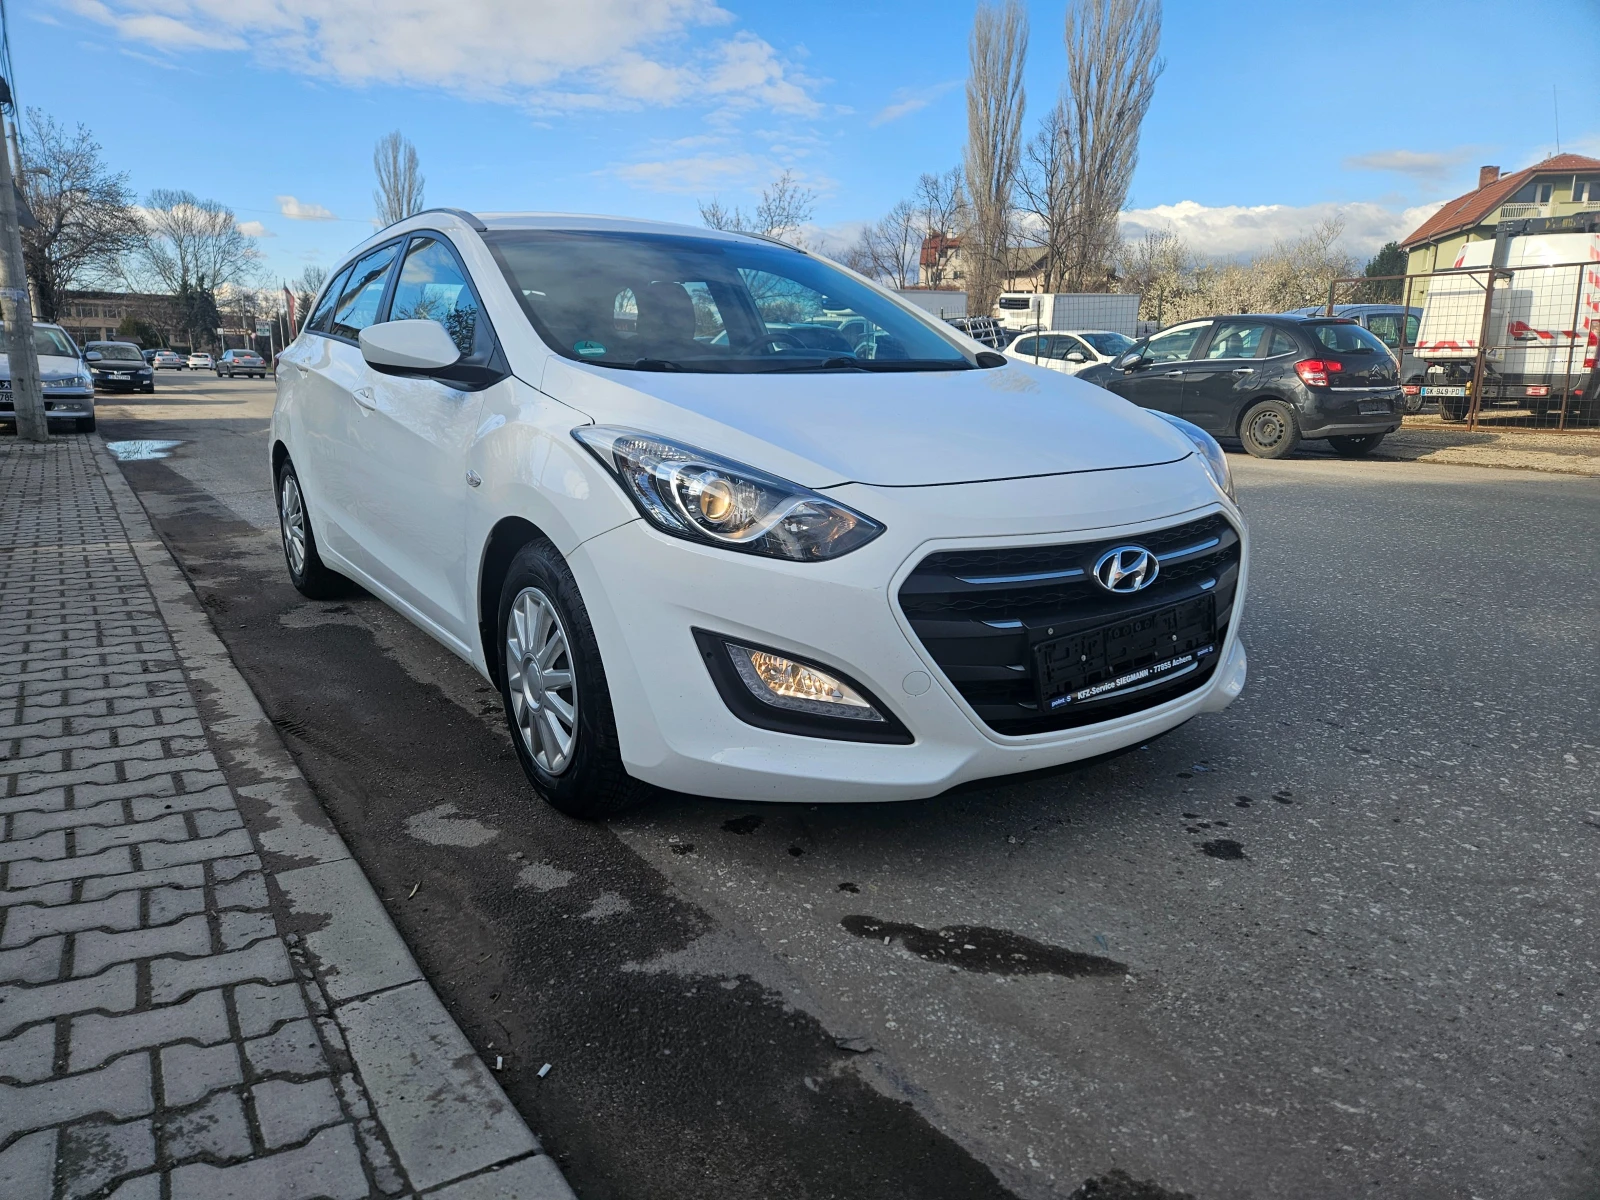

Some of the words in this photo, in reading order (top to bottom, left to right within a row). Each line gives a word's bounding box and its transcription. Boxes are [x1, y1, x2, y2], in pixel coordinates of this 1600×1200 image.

[1077, 682, 1116, 700] KFZ-Service
[1115, 668, 1149, 686] SIEGMANN
[1153, 660, 1172, 673] 77855
[1172, 654, 1193, 667] Achern
[1051, 697, 1066, 708] point
